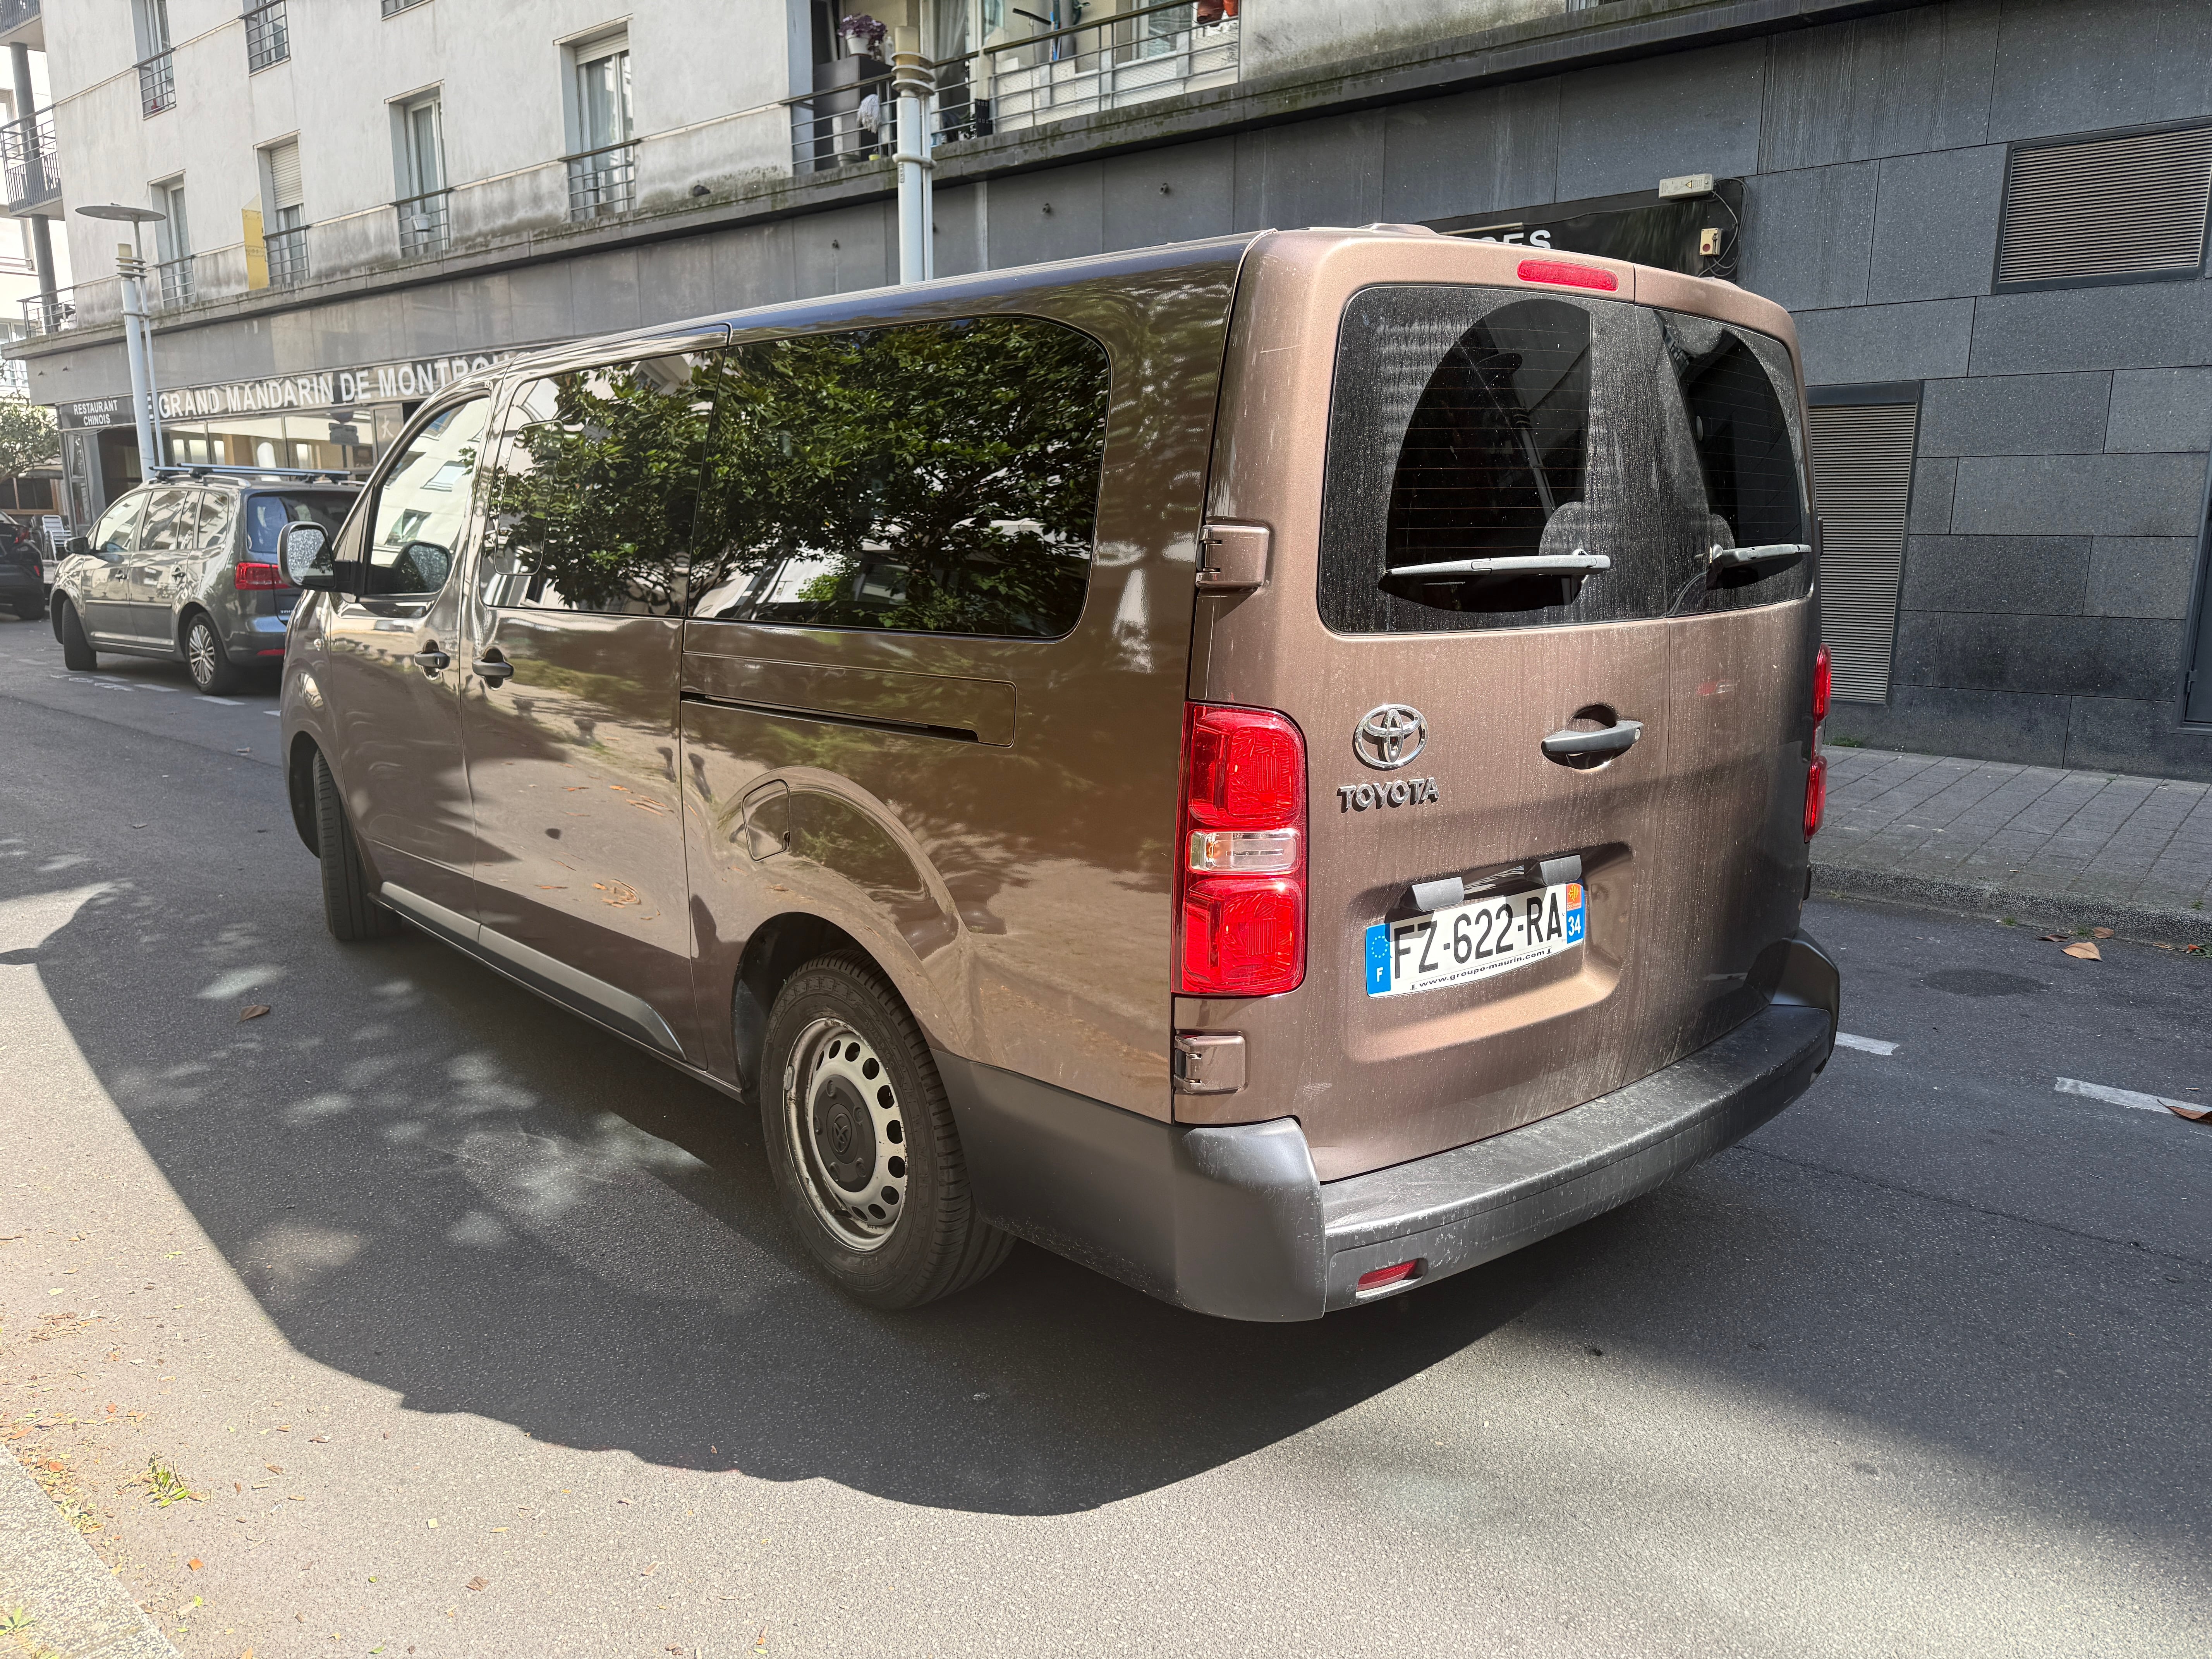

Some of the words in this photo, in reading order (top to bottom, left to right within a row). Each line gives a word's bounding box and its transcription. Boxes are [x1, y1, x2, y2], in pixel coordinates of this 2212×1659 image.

[73, 399, 118, 415] RESTAURANT
[158, 388, 220, 418] GRAND
[226, 374, 335, 412] MANDARIN
[340, 369, 371, 402] DE
[83, 414, 111, 426] CHINOIS
[1337, 777, 1441, 811] TOYOTA
[1376, 967, 1384, 982] F
[1394, 892, 1562, 979] FZ-622-RA
[1568, 914, 1582, 936] 34
[1419, 950, 1545, 988] www.groupe-maurin.com
